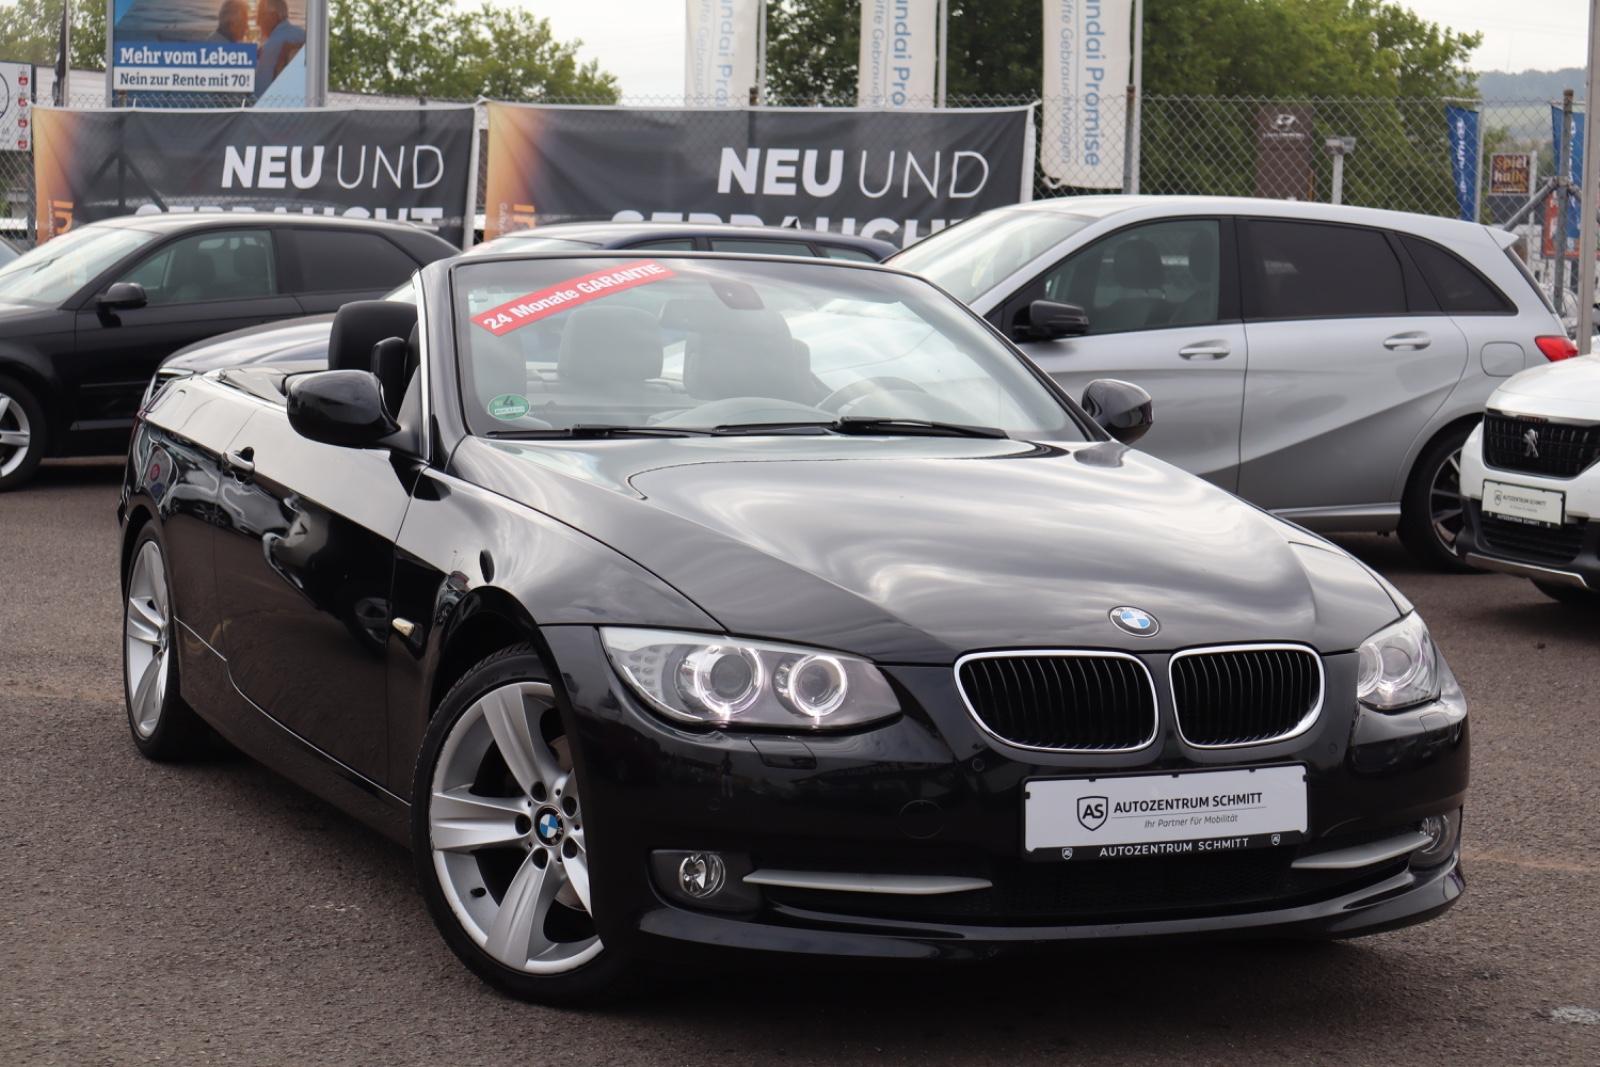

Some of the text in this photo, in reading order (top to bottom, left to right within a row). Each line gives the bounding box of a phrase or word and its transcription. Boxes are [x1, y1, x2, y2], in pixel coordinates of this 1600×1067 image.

[120, 46, 253, 65] Mehr vom Leben.
[120, 72, 250, 87] Nein zur Rente mit 70!
[1060, 28, 1074, 164] Gebrauchtwagen
[1084, 67, 1105, 166] Promise
[221, 144, 444, 190] NEU UND
[717, 147, 990, 199] NEU UND
[482, 263, 666, 331] 24 Monate GARANTIE
[1082, 803, 1105, 820] AS
[1113, 792, 1263, 813] AUTOZENTRUM SCHMITT
[1144, 813, 1239, 829] Ihr Partner für Mobilität
[1099, 837, 1249, 858] AUTOZENTRUM SCHMITT
